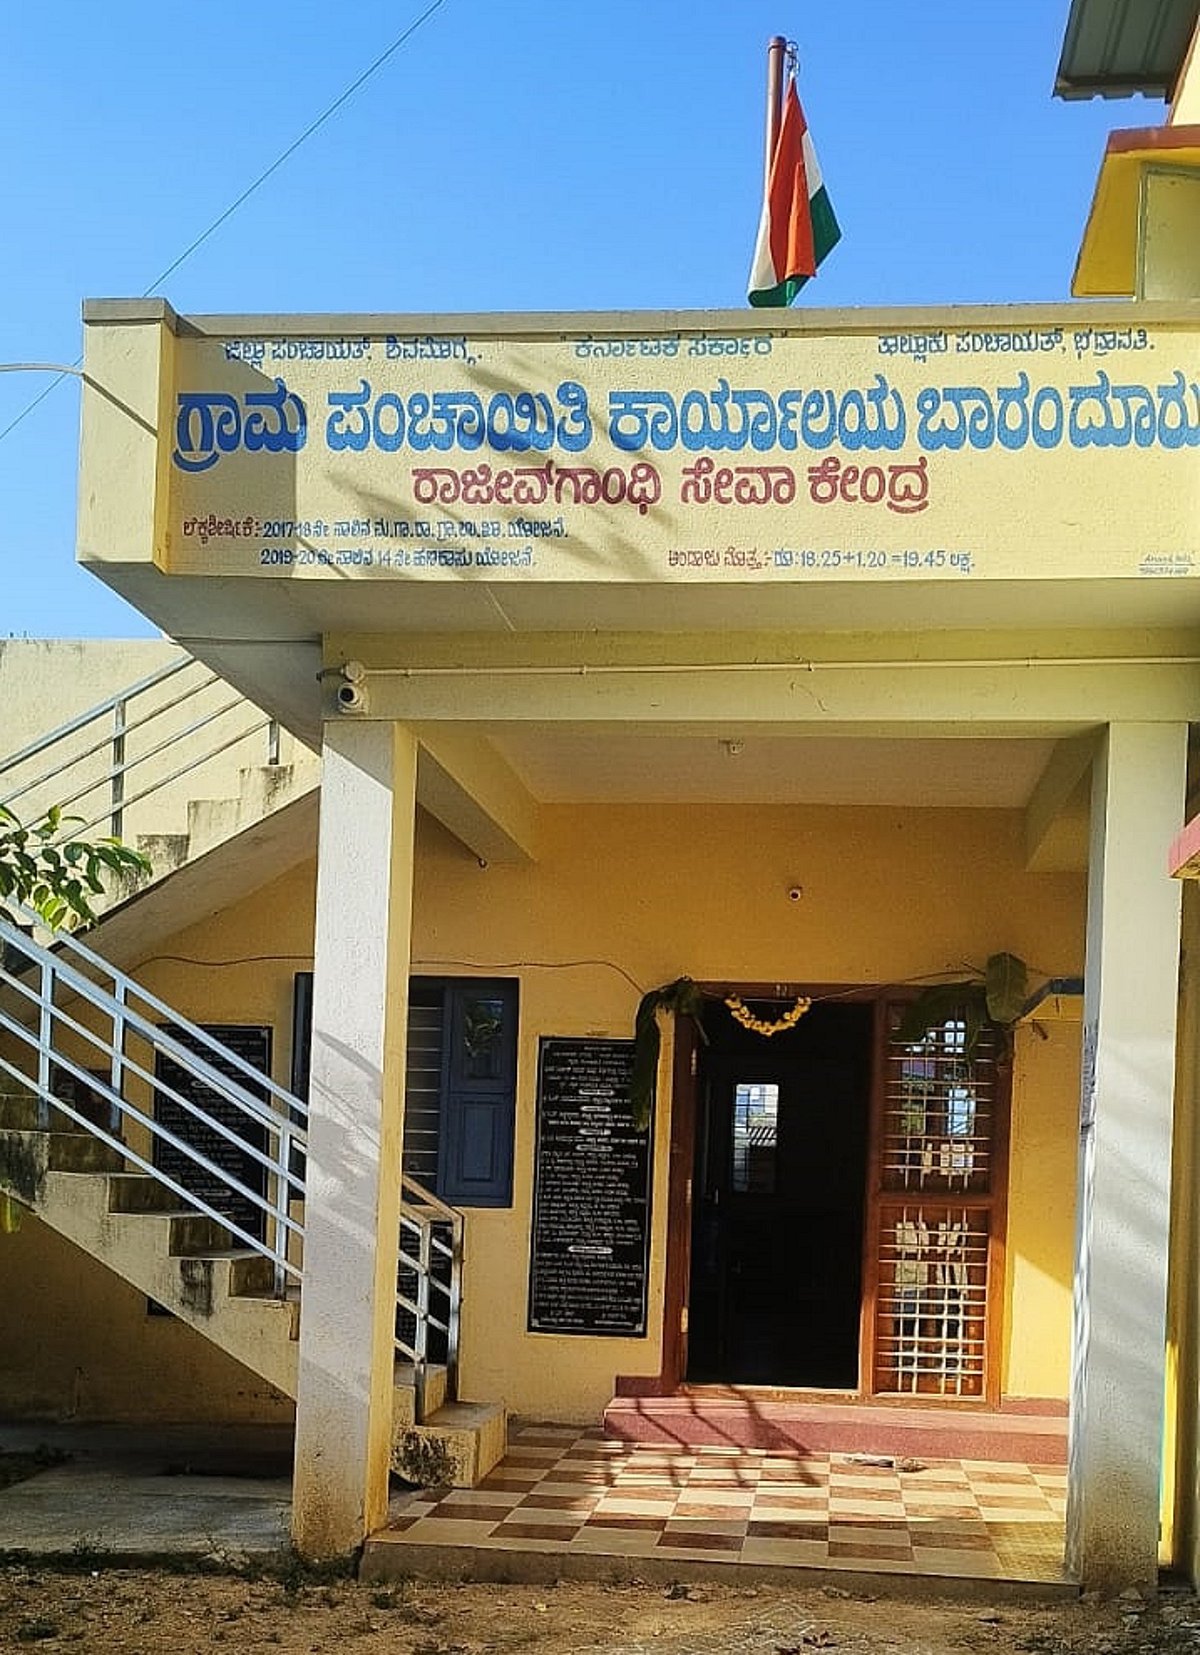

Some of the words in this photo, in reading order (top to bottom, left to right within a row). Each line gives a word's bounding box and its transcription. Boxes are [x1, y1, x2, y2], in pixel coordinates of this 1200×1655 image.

[174, 377, 307, 472] ಗ್ರಾಮ
[326, 379, 592, 451] ಪಂಚಾಯಿತಿ
[608, 373, 906, 451] ಕಾರ್ಯಾಲಯ
[681, 456, 796, 503] ಸೇವಾ
[807, 456, 930, 514] ಕೇಂದ್ರ
